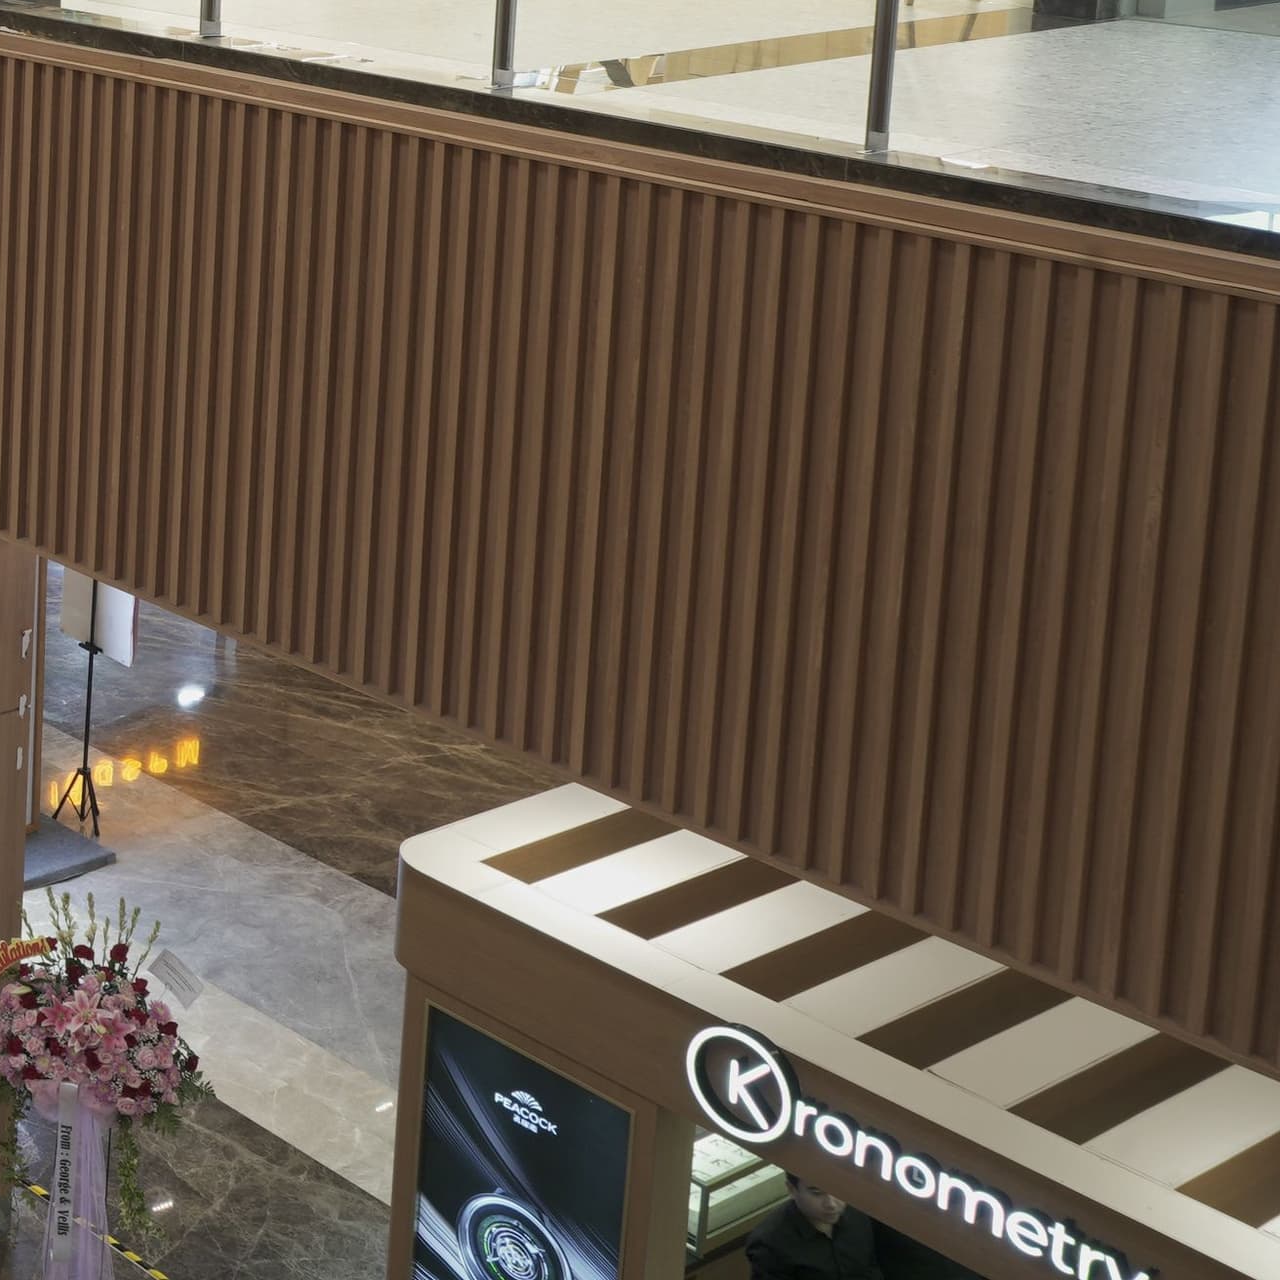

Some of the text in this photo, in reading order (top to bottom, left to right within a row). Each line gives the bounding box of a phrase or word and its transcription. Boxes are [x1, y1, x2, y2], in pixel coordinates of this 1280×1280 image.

[494, 1091, 558, 1136] PEACOCK
[60, 1124, 73, 1150] From
[57, 1159, 72, 1195] George
[59, 1196, 71, 1205] &
[57, 1210, 70, 1236] Vellis
